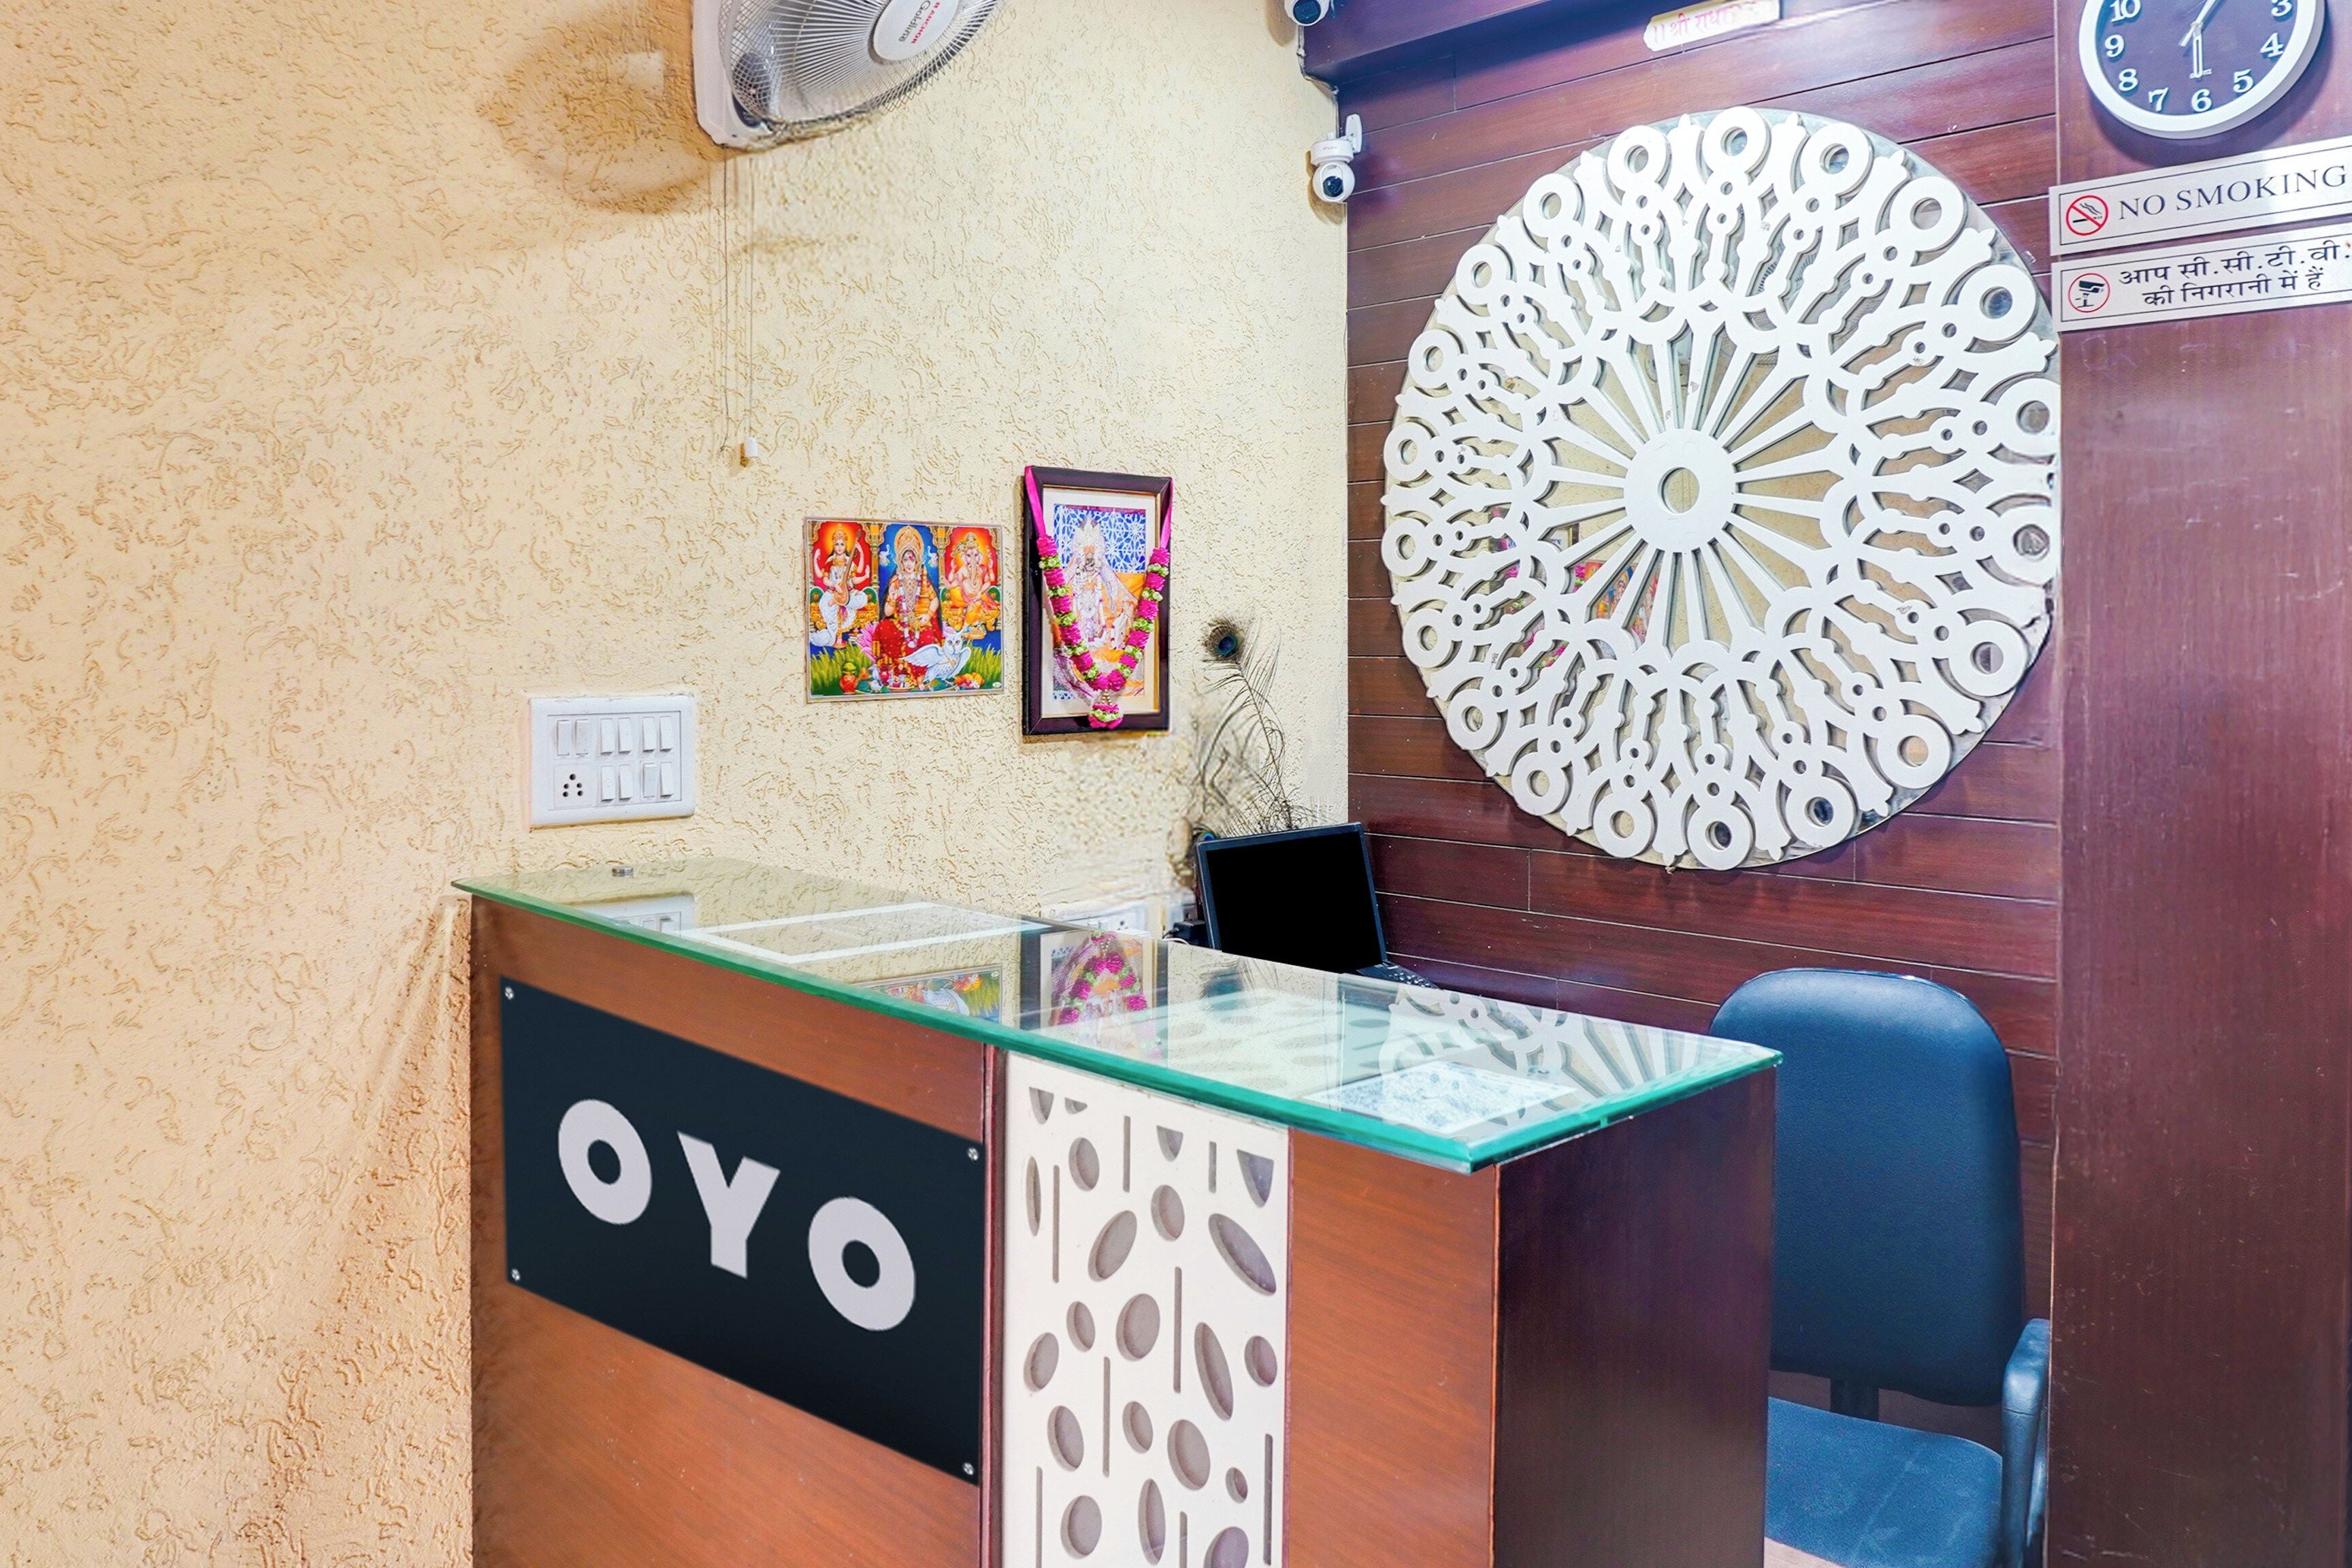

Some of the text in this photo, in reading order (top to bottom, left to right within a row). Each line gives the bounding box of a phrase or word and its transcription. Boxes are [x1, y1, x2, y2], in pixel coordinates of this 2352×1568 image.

[2110, 0, 2141, 22] 10
[2271, 0, 2293, 16] 3
[2105, 35, 2125, 57] 9
[2260, 33, 2283, 58] 4
[2118, 68, 2138, 91] 8
[2233, 69, 2254, 93] 5
[2149, 87, 2169, 112] 7
[2191, 89, 2212, 112] 6
[2119, 165, 2347, 220] NO SMOKING
[2119, 266, 2171, 284] आप
[2142, 266, 2325, 306] की निगरानी में हैं
[558, 1098, 916, 1331] OYO
